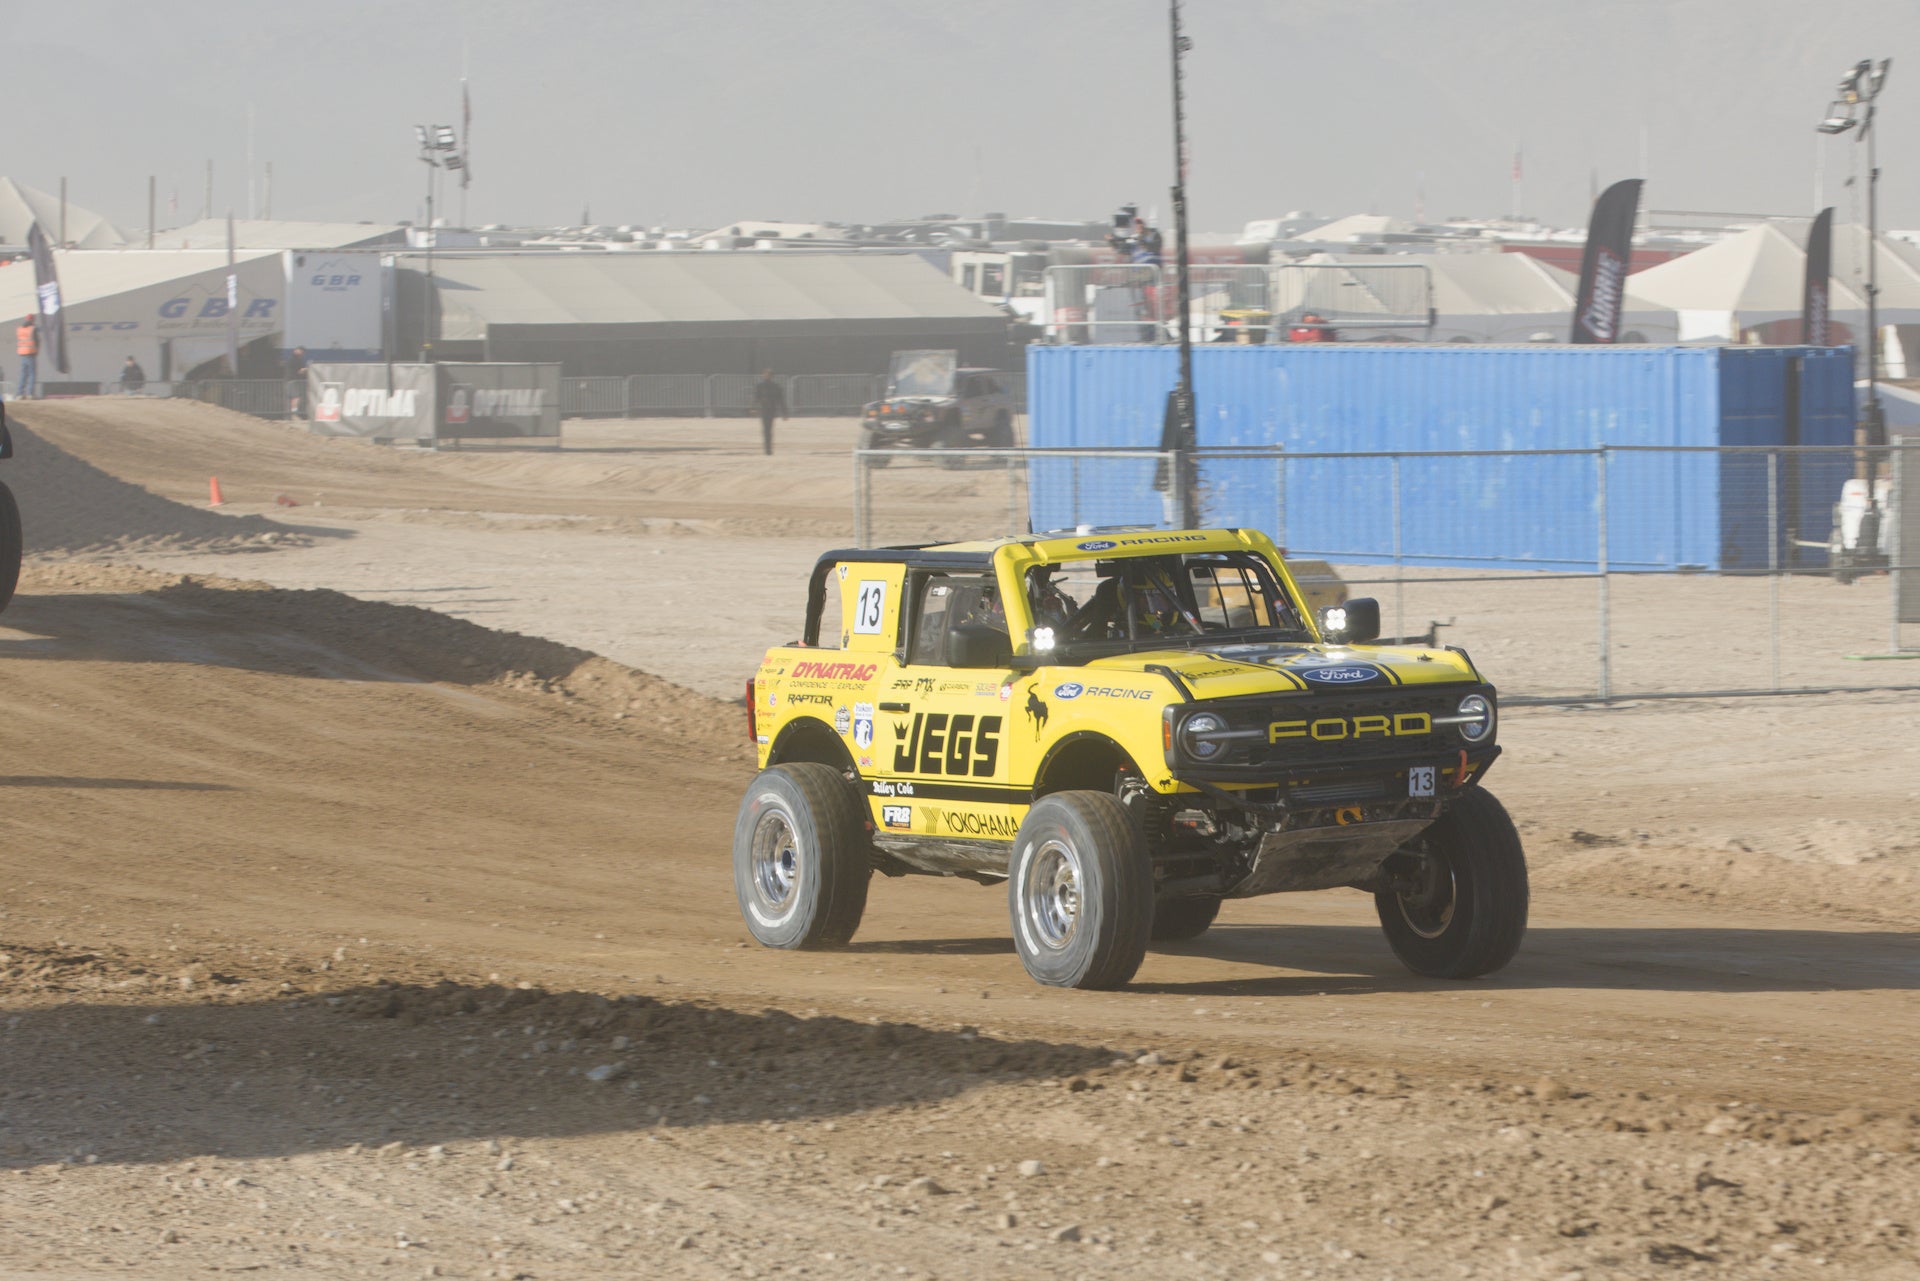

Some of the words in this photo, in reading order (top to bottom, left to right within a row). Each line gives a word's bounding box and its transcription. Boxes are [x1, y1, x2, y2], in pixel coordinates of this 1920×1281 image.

[311, 274, 362, 286] GBR
[157, 297, 278, 319] GBR
[473, 388, 547, 417] OPTIMA
[1120, 535, 1207, 546] RACING
[860, 587, 881, 627] 13
[791, 661, 878, 681] DYNATRAC
[787, 693, 834, 708] RAPTOR
[1085, 686, 1154, 700] RACING
[1269, 712, 1432, 744] FORD
[893, 712, 1003, 778] JEGS
[896, 782, 914, 795] Cole
[1411, 771, 1434, 791] 13
[941, 811, 1020, 837] YOKOHAMA
